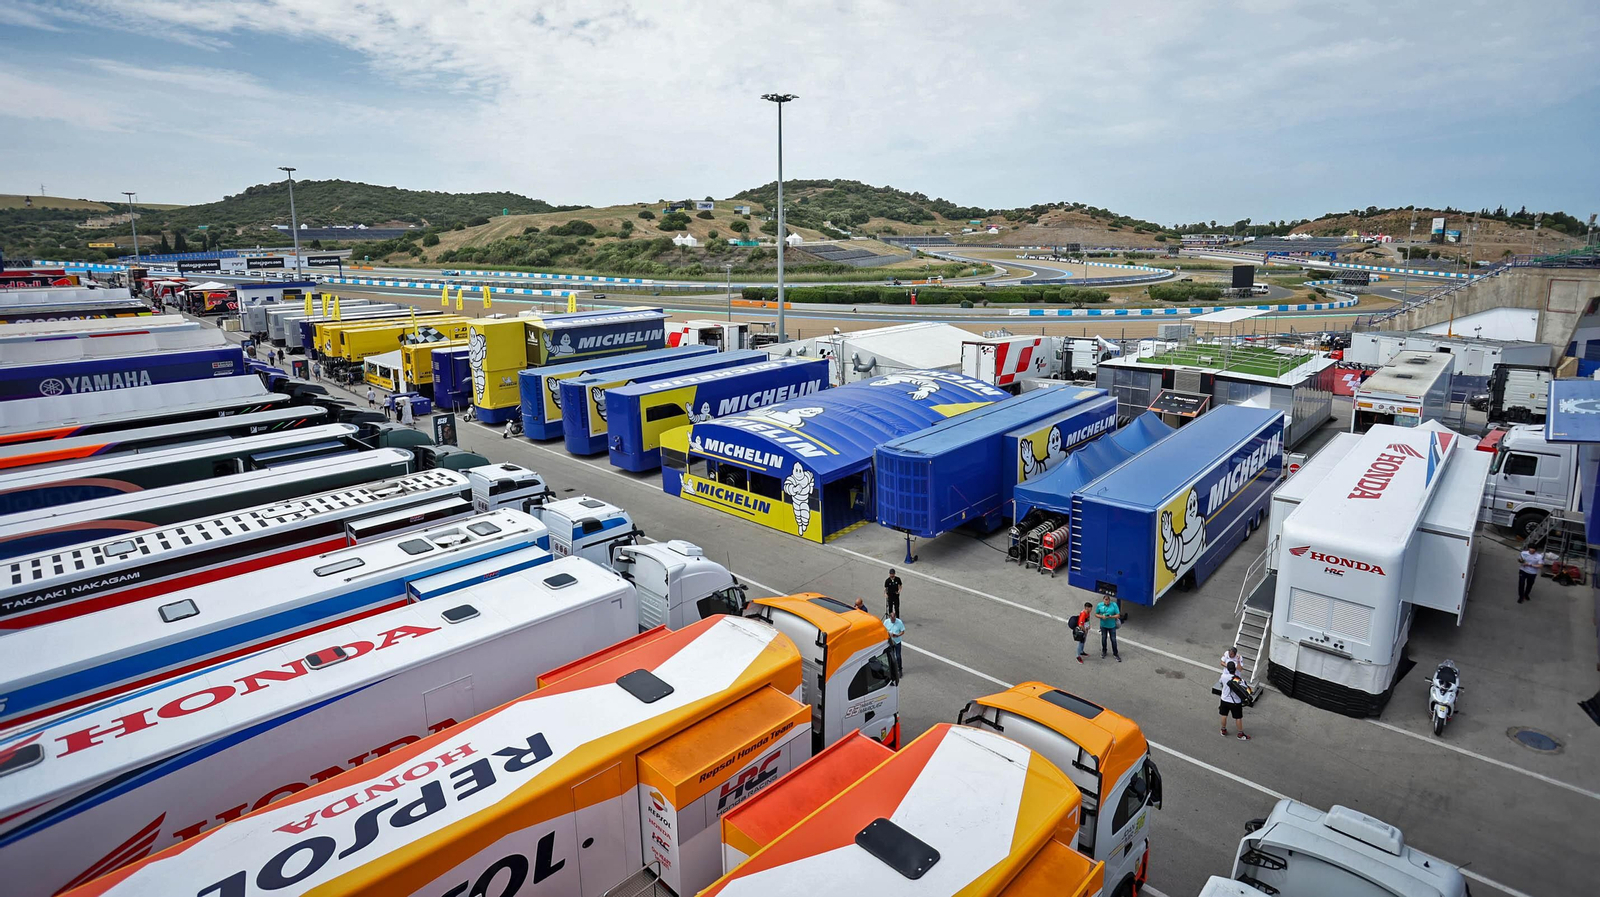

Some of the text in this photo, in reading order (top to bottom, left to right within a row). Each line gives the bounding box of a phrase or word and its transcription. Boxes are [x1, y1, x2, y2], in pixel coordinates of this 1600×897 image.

[577, 328, 664, 350] MICHELIN
[65, 370, 152, 394] YAMAHA
[649, 363, 780, 390] MICHELIN
[717, 379, 821, 416] MICHELIN
[1066, 413, 1116, 448] MICHELIN
[704, 437, 784, 469] MICHELIN
[1206, 430, 1281, 516] MICHELIN
[1346, 452, 1407, 499] HONDA
[696, 481, 771, 514] MICHELIN
[1310, 551, 1387, 576] HONDA
[1324, 566, 1345, 577] HRC
[1, 571, 140, 610] TAKAAKI NAKAGAMI
[55, 624, 442, 758] HONDA
[699, 721, 794, 784] Repsol Honda Team
[272, 742, 479, 835] HONDA
[717, 749, 781, 811] HRC
[647, 805, 672, 830] REPSOL
